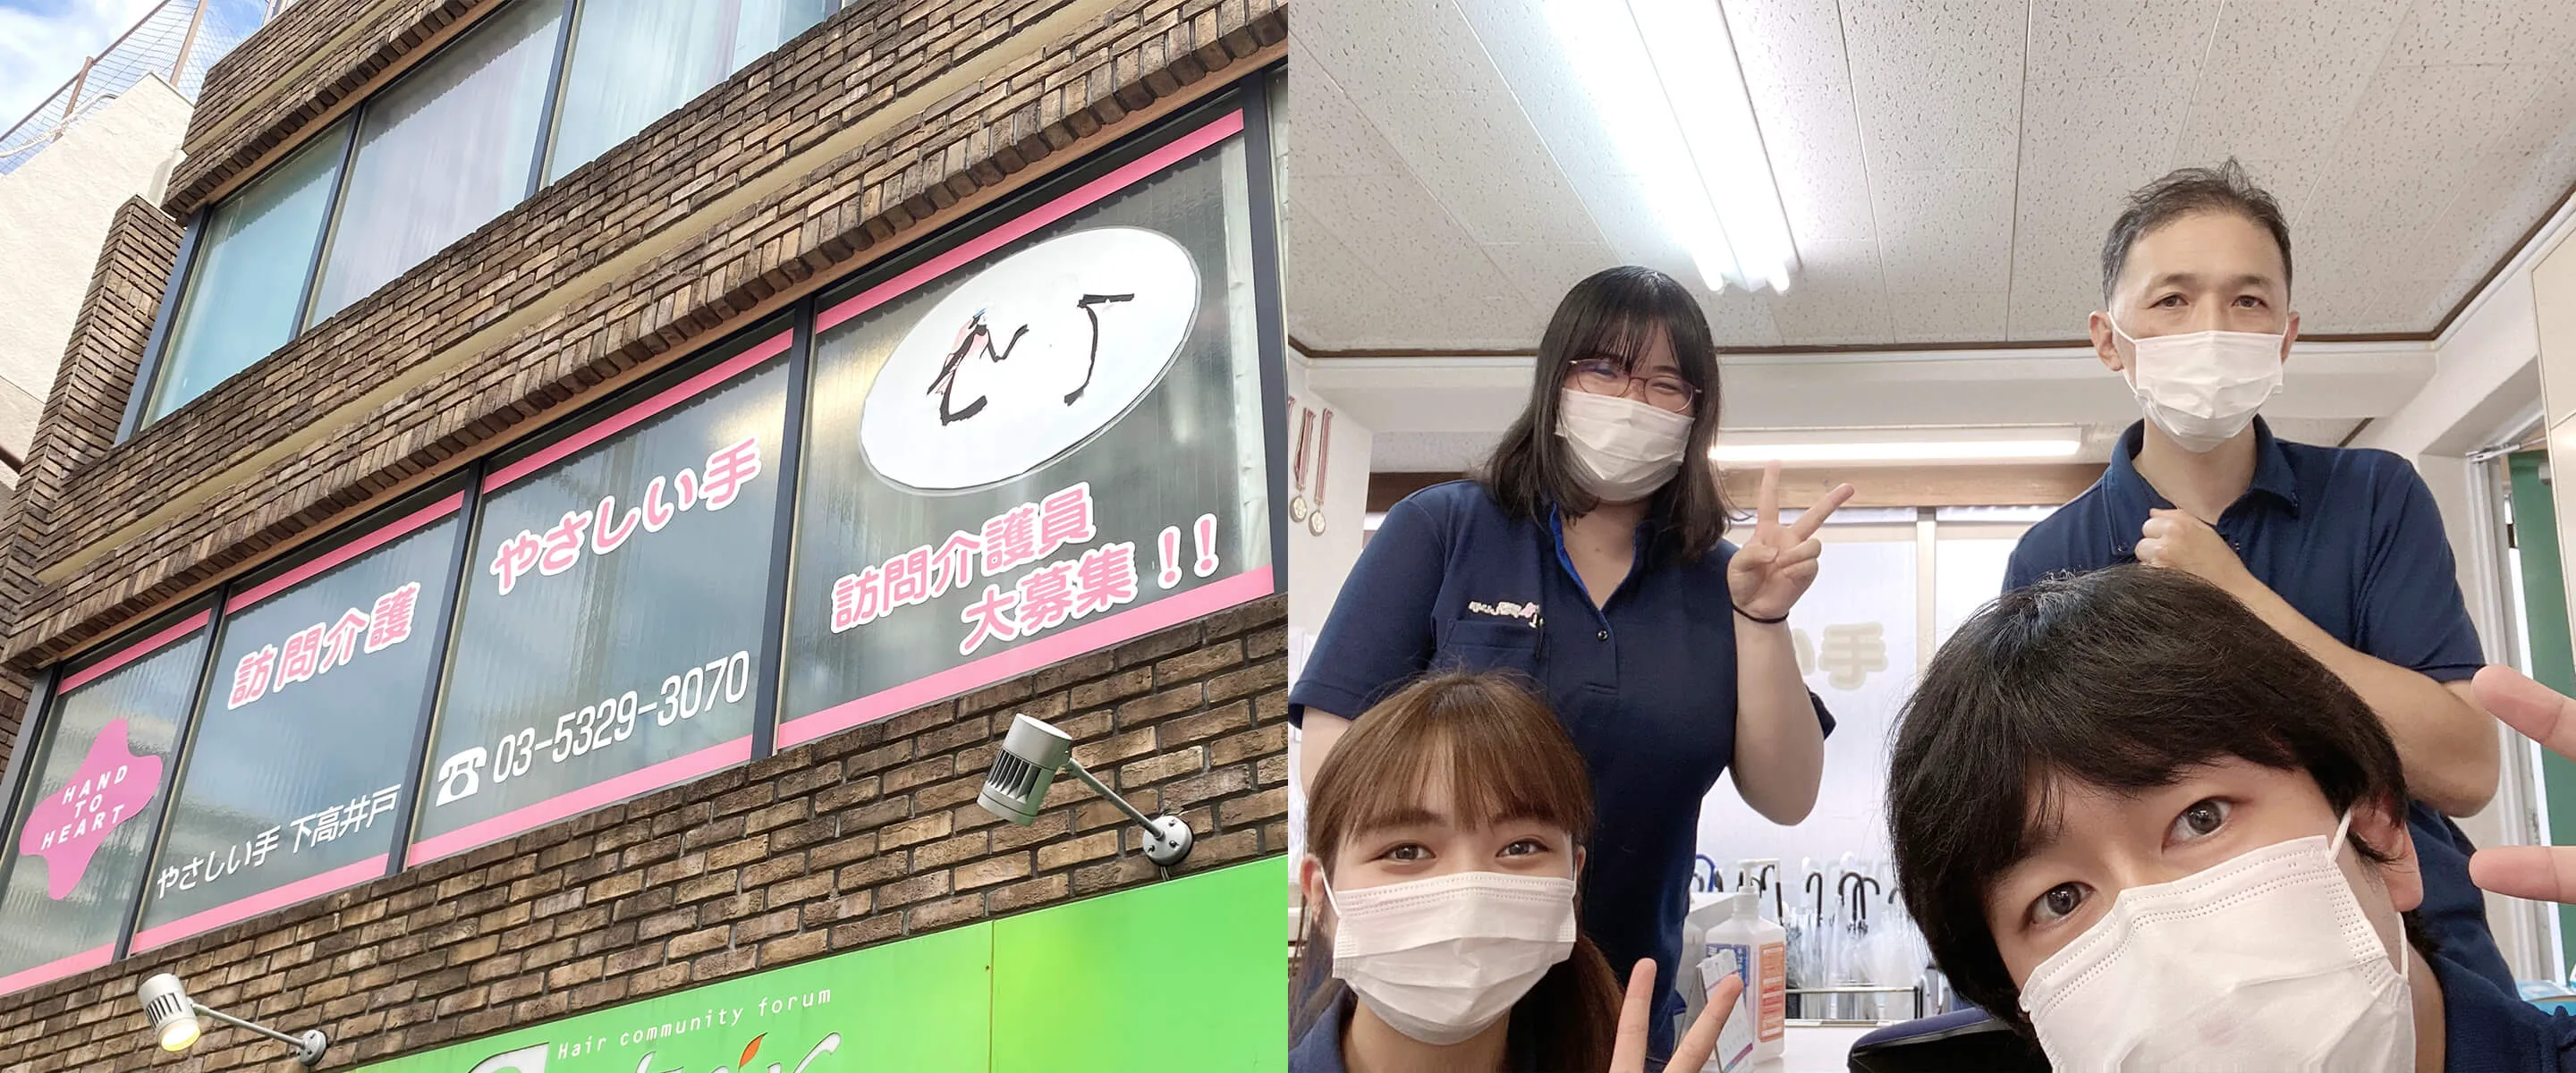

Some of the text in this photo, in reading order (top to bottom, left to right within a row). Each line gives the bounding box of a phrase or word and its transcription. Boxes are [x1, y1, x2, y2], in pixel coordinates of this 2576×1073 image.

[490, 435, 763, 596] やさしい手
[831, 481, 1097, 634] 訪問介護員
[227, 581, 421, 710] 訪問介護
[493, 650, 750, 784] 03-5329-3070
[41, 804, 124, 850] HEART
[64, 765, 128, 802] HAND
[74, 793, 102, 818] TO
[157, 783, 401, 899] やさしい手 下高井戸
[557, 1035, 607, 1060] Hair
[620, 1007, 743, 1045] community
[758, 986, 832, 1018] forum
